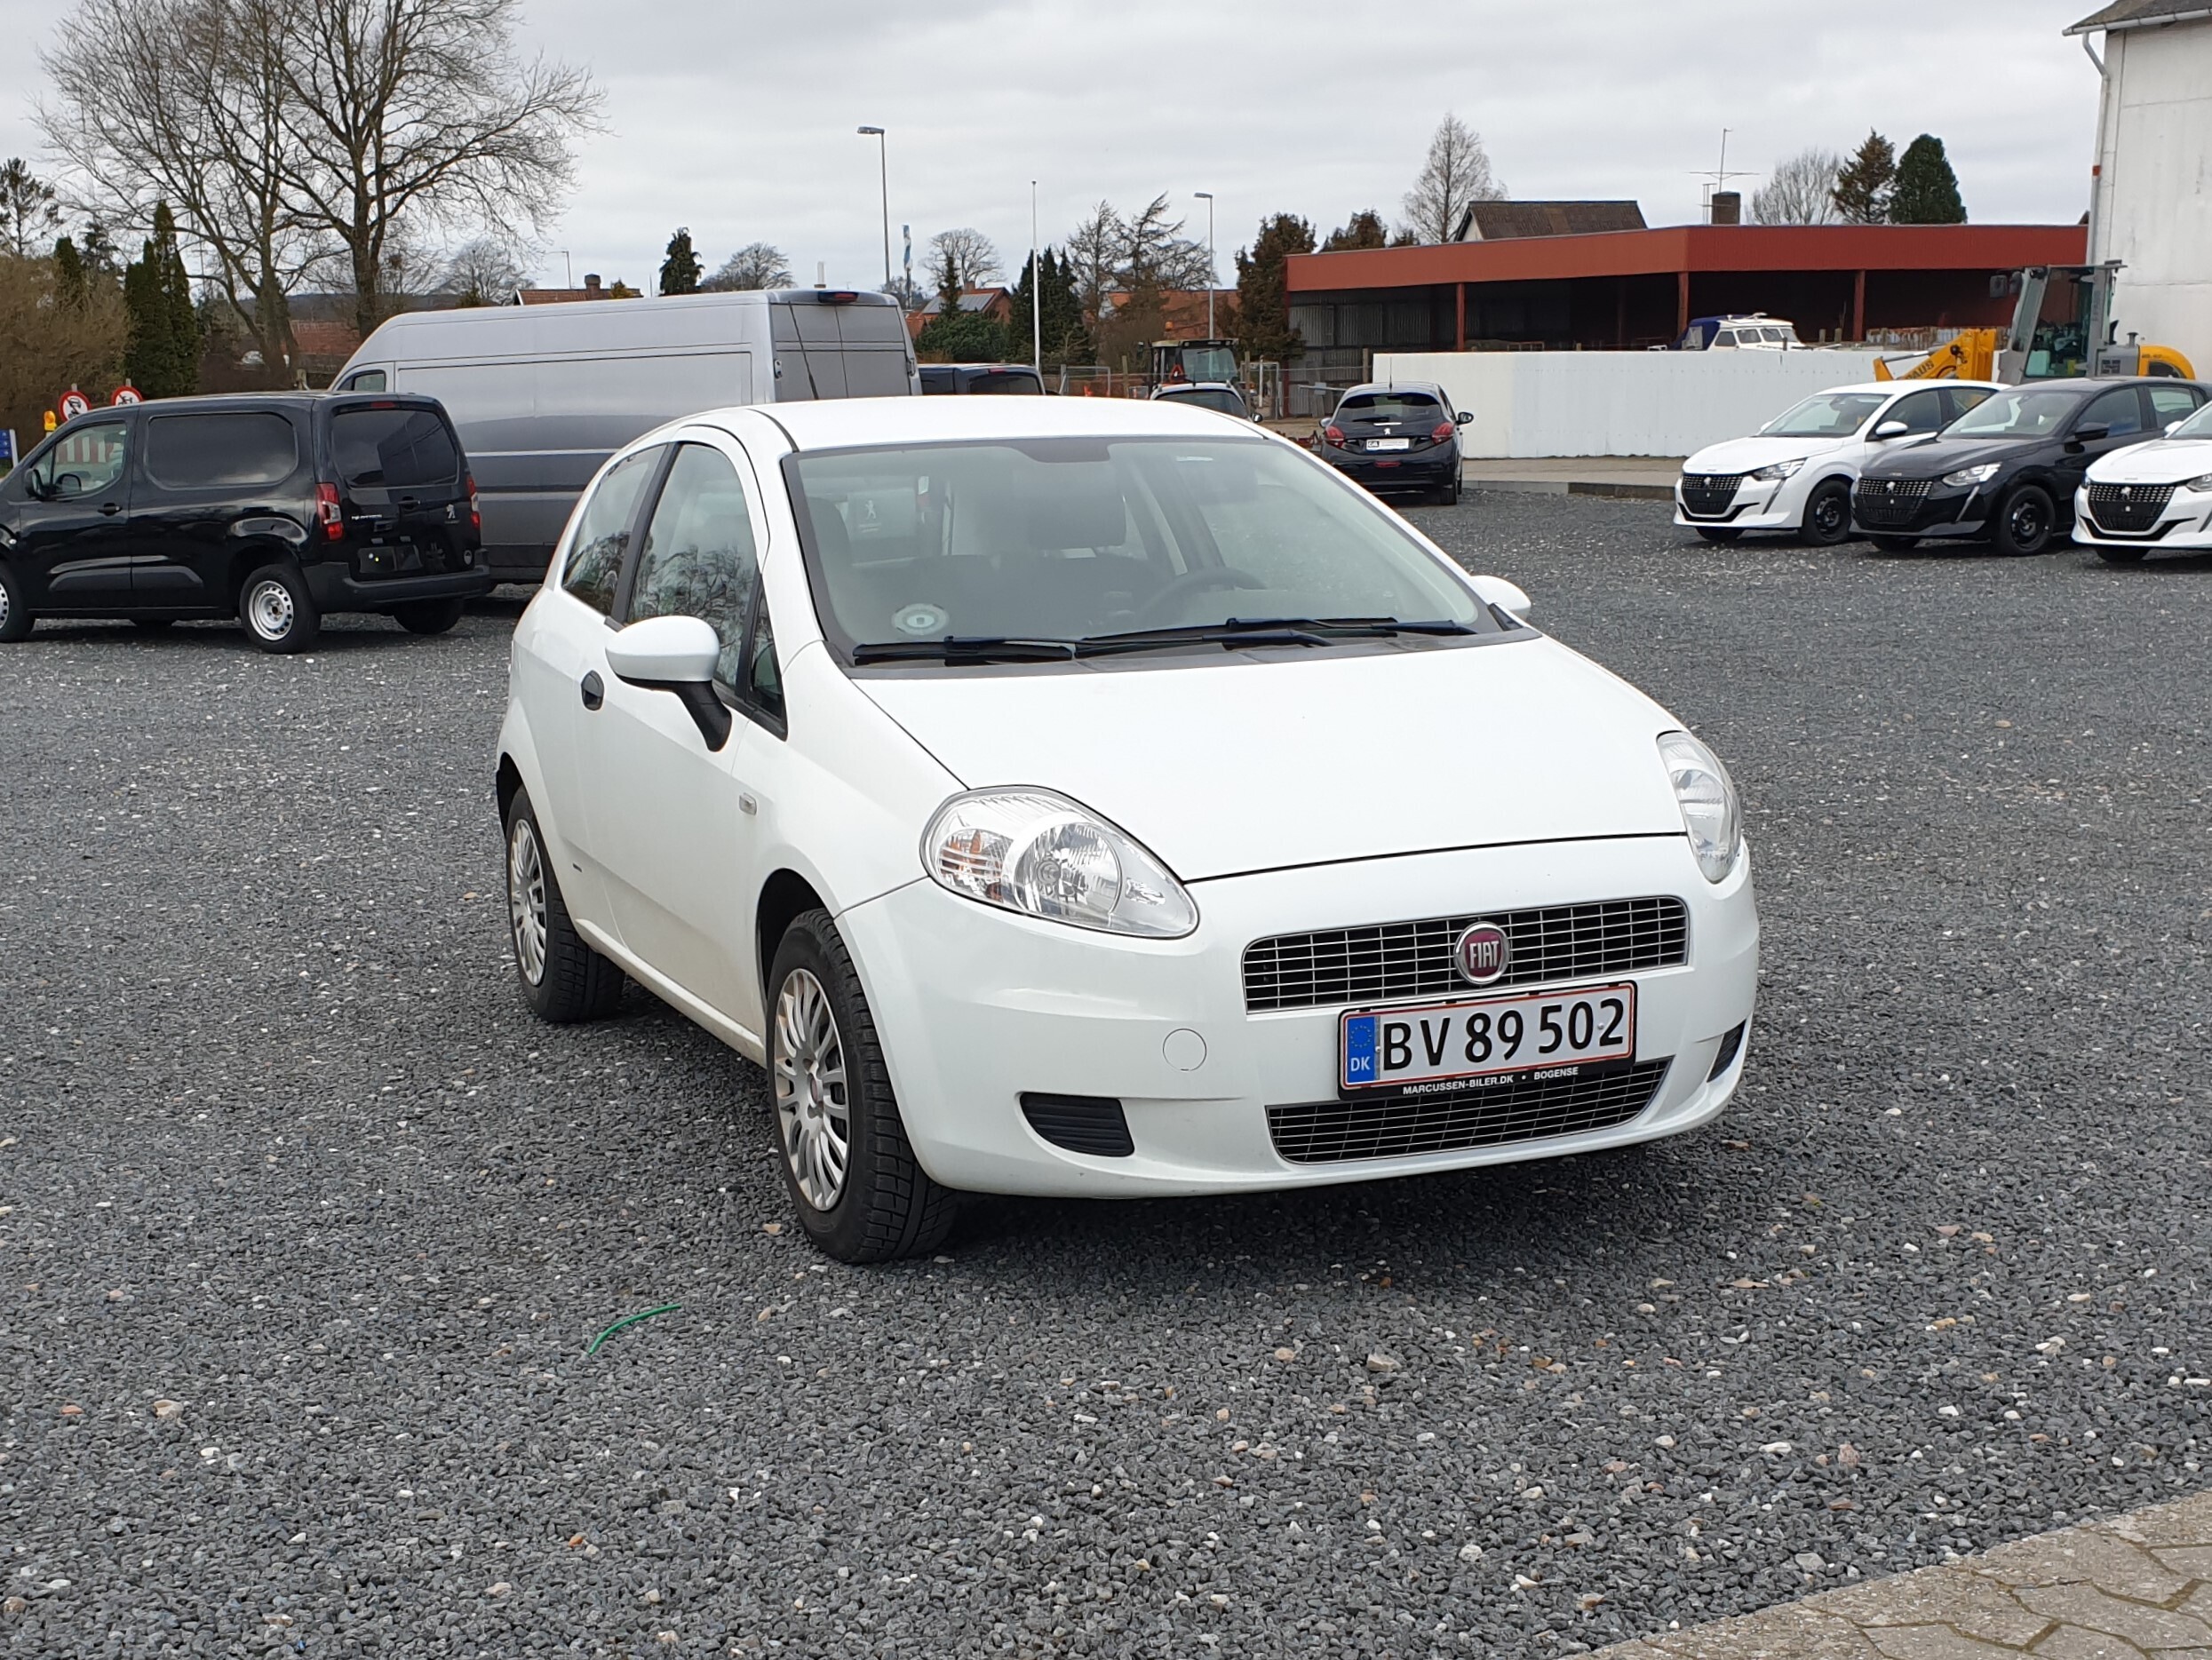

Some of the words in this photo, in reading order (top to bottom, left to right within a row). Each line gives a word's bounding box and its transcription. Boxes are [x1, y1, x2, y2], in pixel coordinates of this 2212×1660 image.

[1469, 941, 1500, 969] FIAT
[1383, 1017, 1450, 1070] BV
[1465, 1010, 1524, 1063] 89
[1539, 997, 1624, 1054] 502
[1350, 1056, 1371, 1072] DK
[1403, 1075, 1514, 1095] MARCUSSEN-BILER.DK
[1533, 1067, 1579, 1080] BOGENSE
